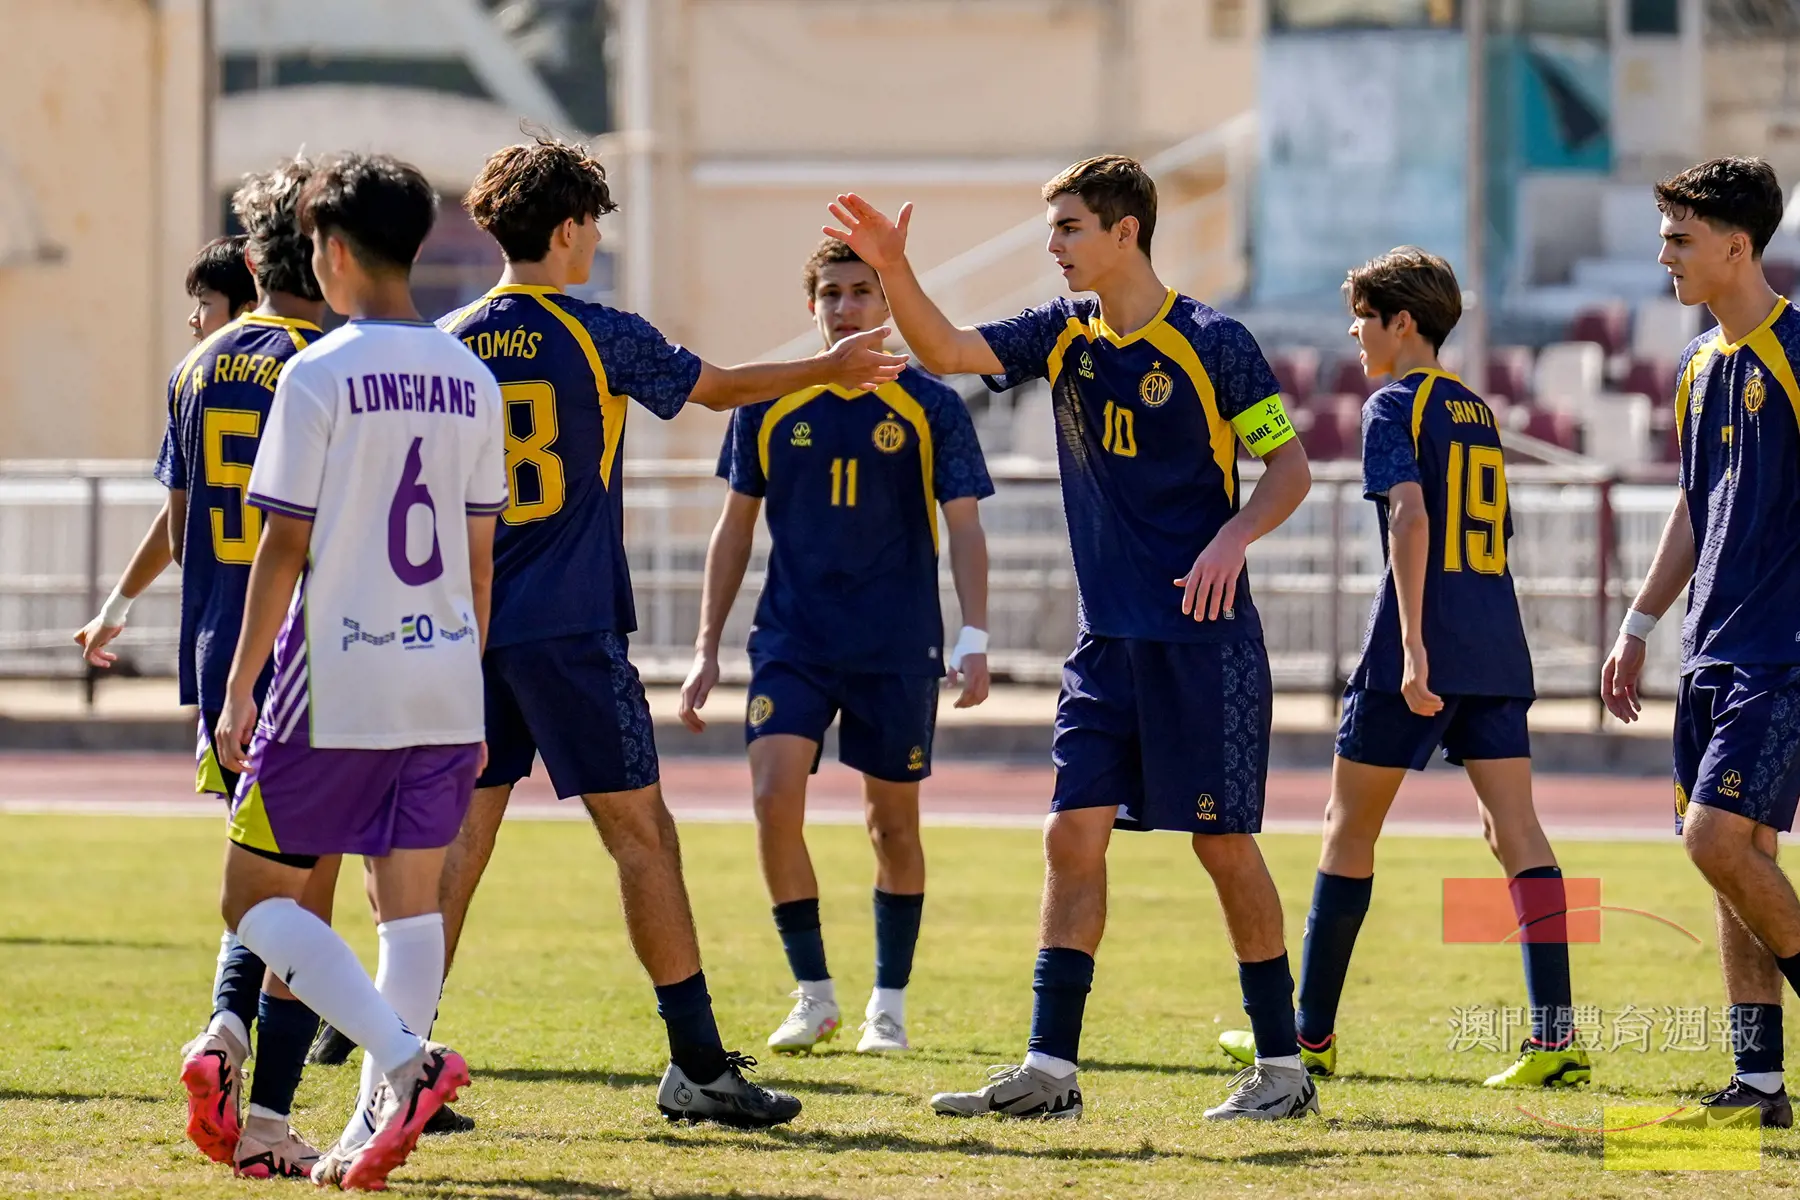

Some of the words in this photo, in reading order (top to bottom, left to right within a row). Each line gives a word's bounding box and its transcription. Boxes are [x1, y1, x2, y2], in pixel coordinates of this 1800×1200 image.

[346, 373, 476, 418] LONGHANG
[1445, 400, 1491, 428] SANTI
[498, 380, 566, 526] 8
[1102, 399, 1138, 459] 10
[1245, 423, 1272, 445] DARE
[1273, 413, 1286, 427] TO
[203, 407, 262, 565] 5
[388, 436, 443, 587] 6
[829, 457, 858, 507] 11
[1444, 440, 1507, 577] 19
